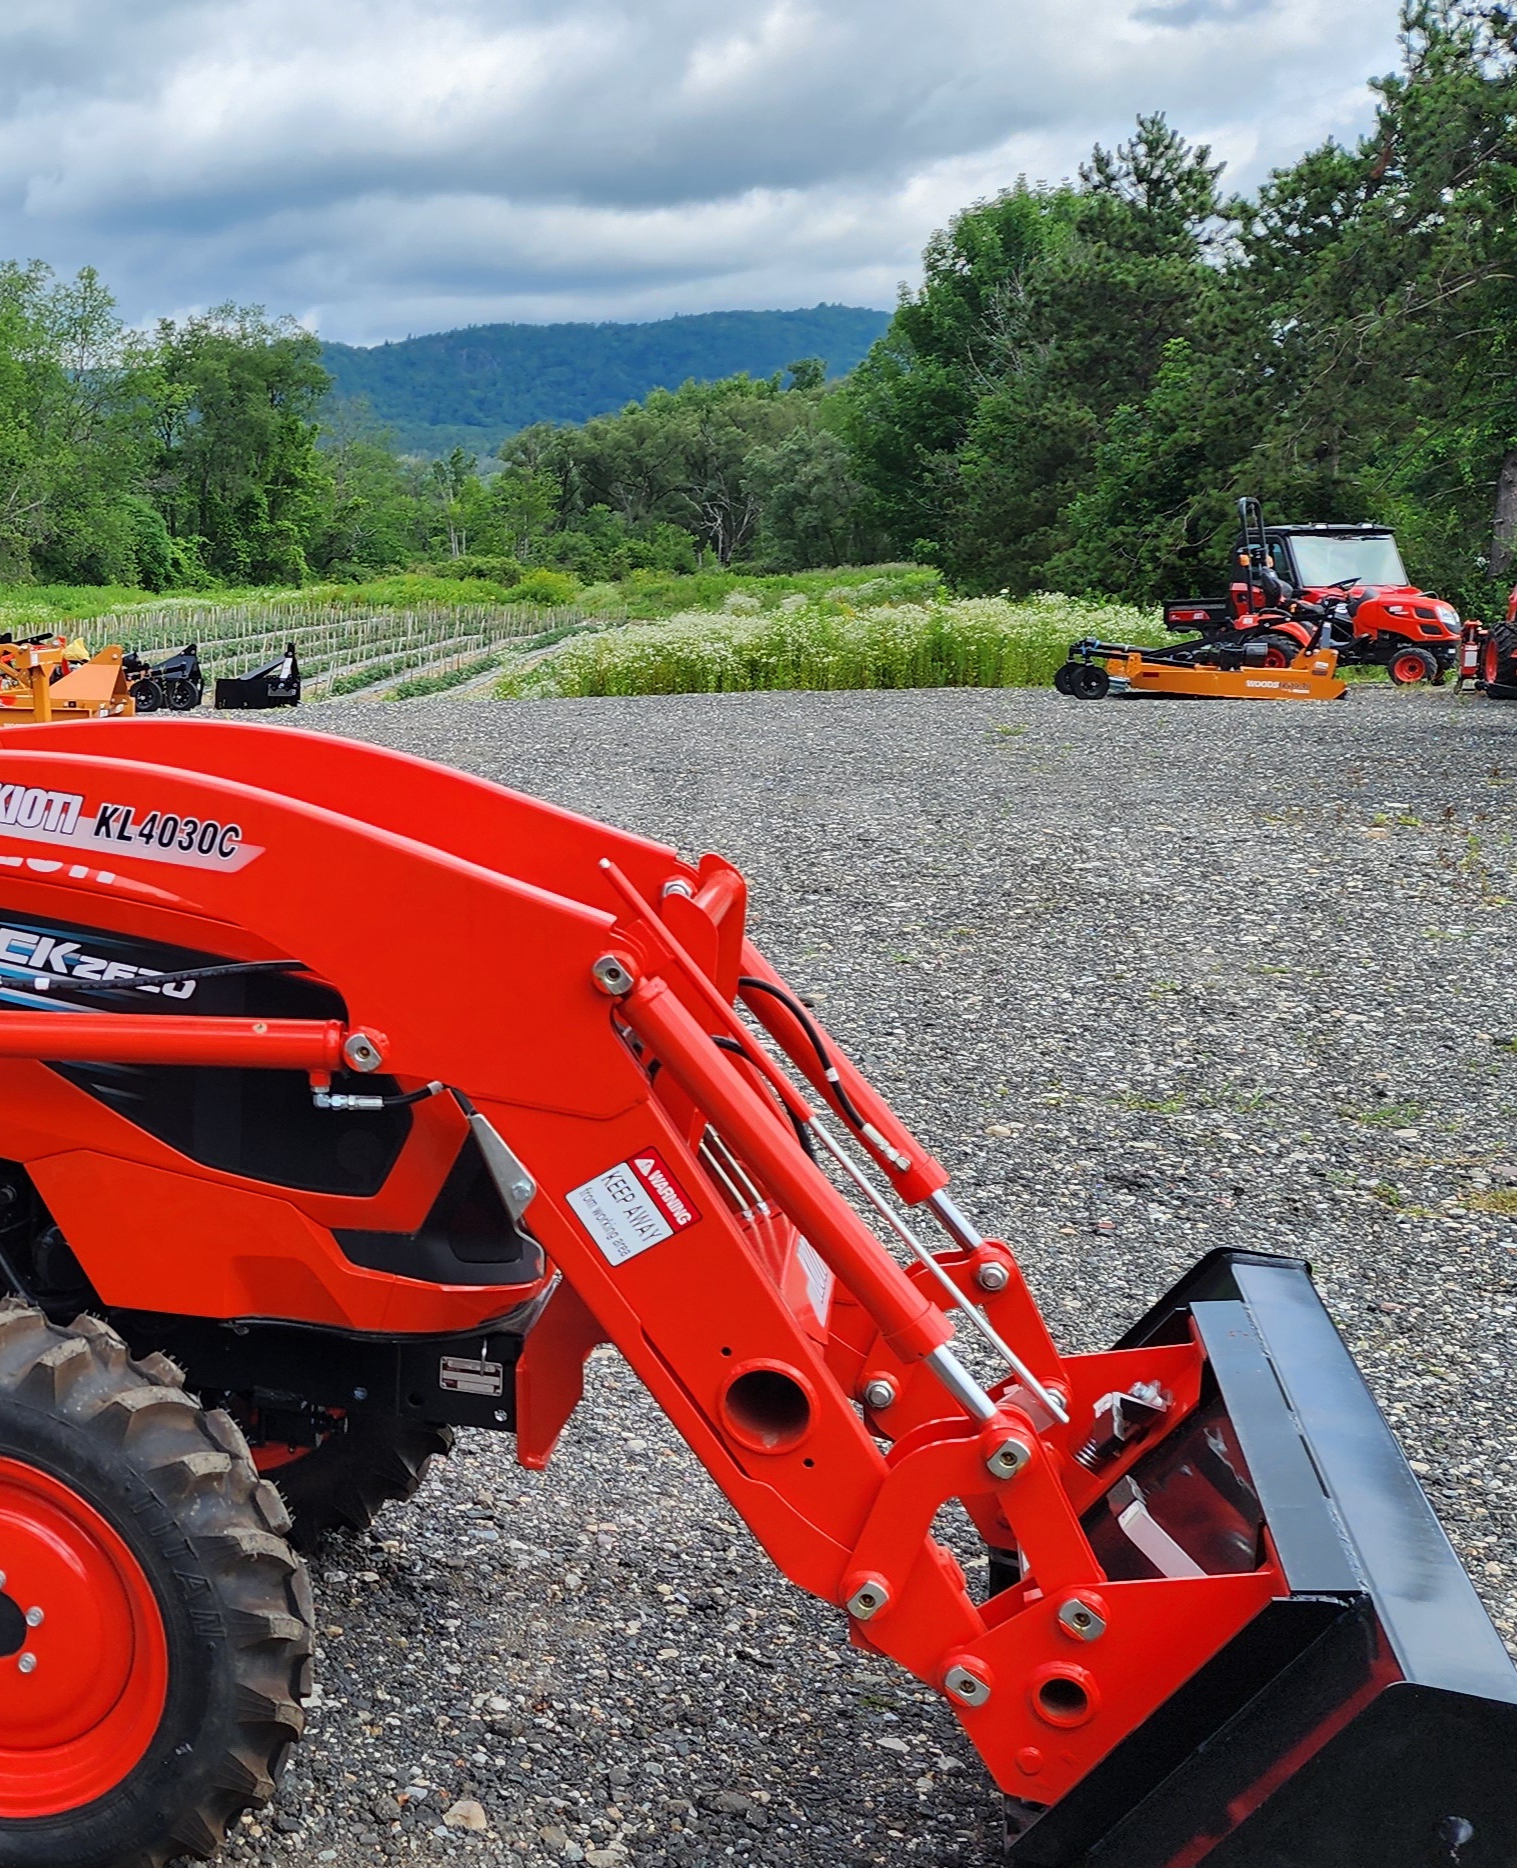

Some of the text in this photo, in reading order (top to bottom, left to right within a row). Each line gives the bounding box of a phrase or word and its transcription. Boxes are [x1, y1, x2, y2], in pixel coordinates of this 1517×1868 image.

[93, 803, 241, 860] KL4030C
[579, 1186, 631, 1257] from working area
[601, 1170, 662, 1242] KEEP AWAY
[648, 1169, 692, 1226] WARNING
[130, 1489, 227, 1638] TITAN
